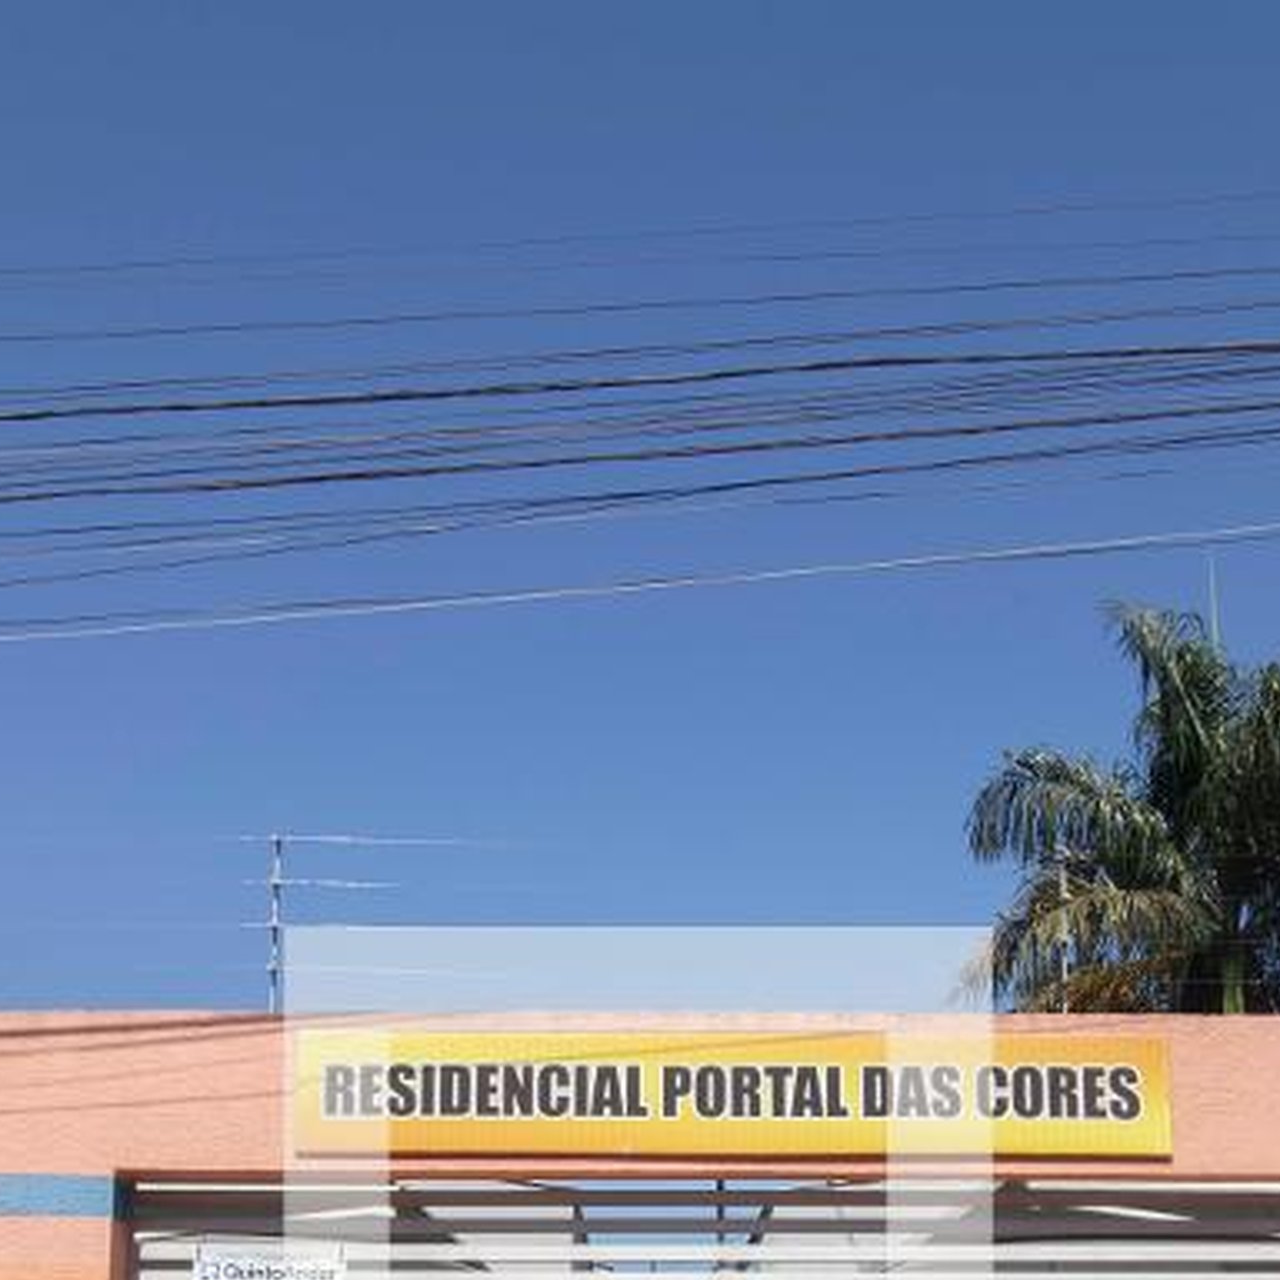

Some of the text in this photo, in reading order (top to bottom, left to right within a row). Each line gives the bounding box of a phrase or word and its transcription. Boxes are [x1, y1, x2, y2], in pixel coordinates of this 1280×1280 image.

[323, 1063, 1141, 1119] RESIDENCIAL PORTAL DAS CORES
